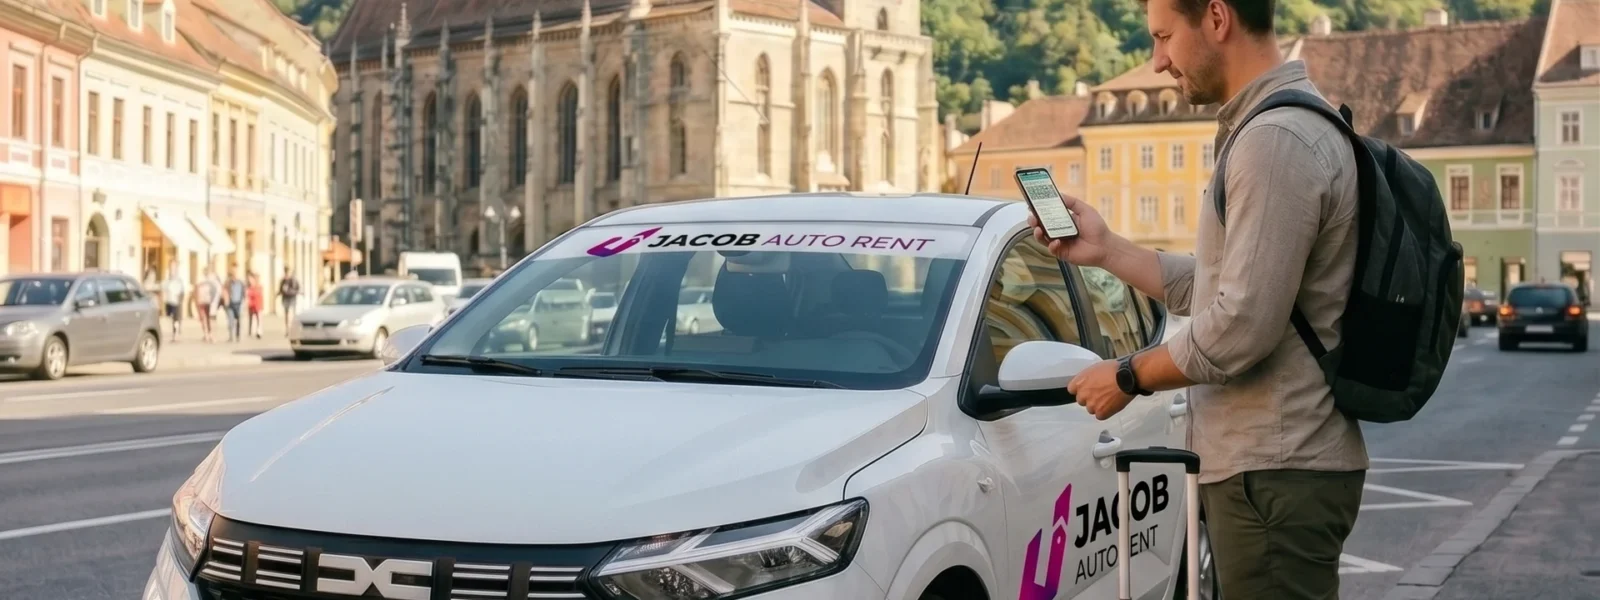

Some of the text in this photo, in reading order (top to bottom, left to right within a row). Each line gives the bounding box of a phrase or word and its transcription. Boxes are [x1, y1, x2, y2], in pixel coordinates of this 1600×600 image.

[647, 233, 936, 251] JACOB AUTO RENT
[1074, 524, 1158, 585] AUTO ENT
